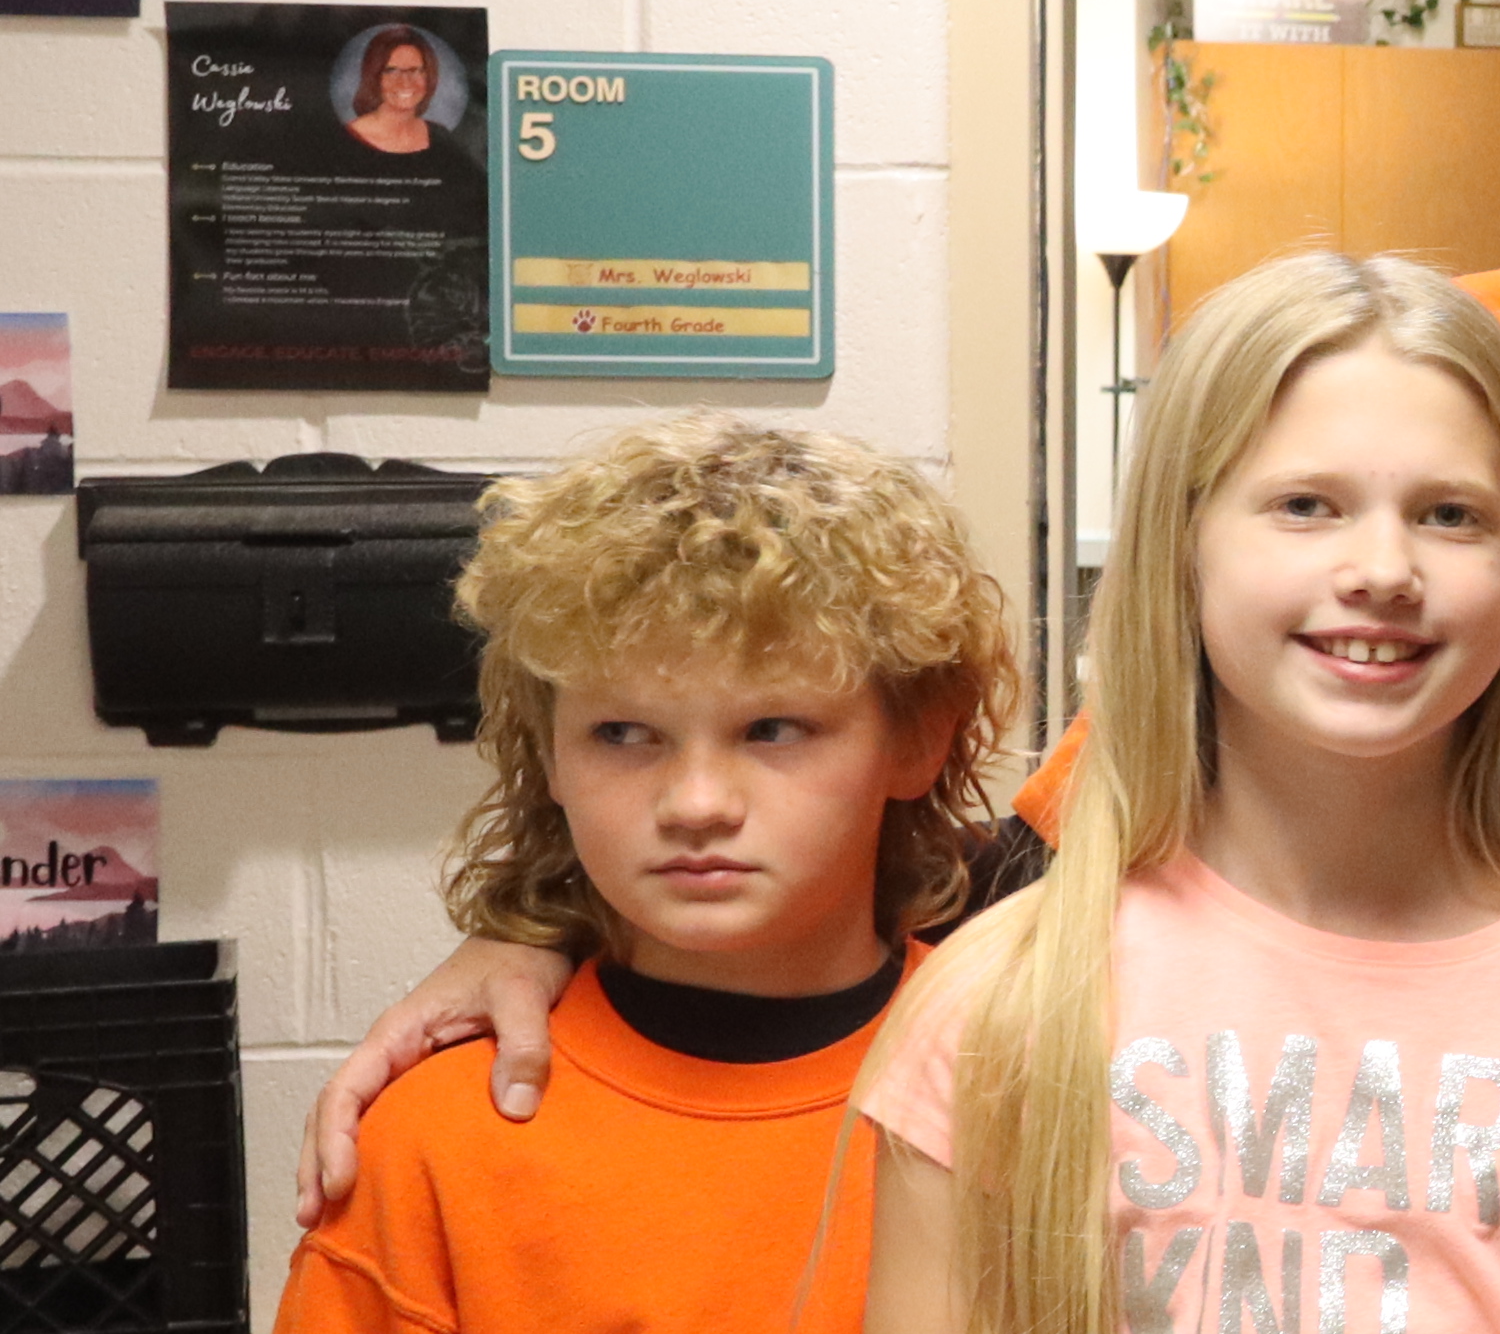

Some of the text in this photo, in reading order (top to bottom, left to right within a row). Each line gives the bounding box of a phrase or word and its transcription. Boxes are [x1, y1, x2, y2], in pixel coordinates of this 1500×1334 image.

[191, 55, 255, 77] Cassie
[517, 75, 625, 104] ROOM
[191, 86, 293, 127] Weglowski
[518, 112, 557, 161] 5
[598, 267, 752, 289] Mrs. Weglowski
[601, 317, 725, 334] Fourth Grade
